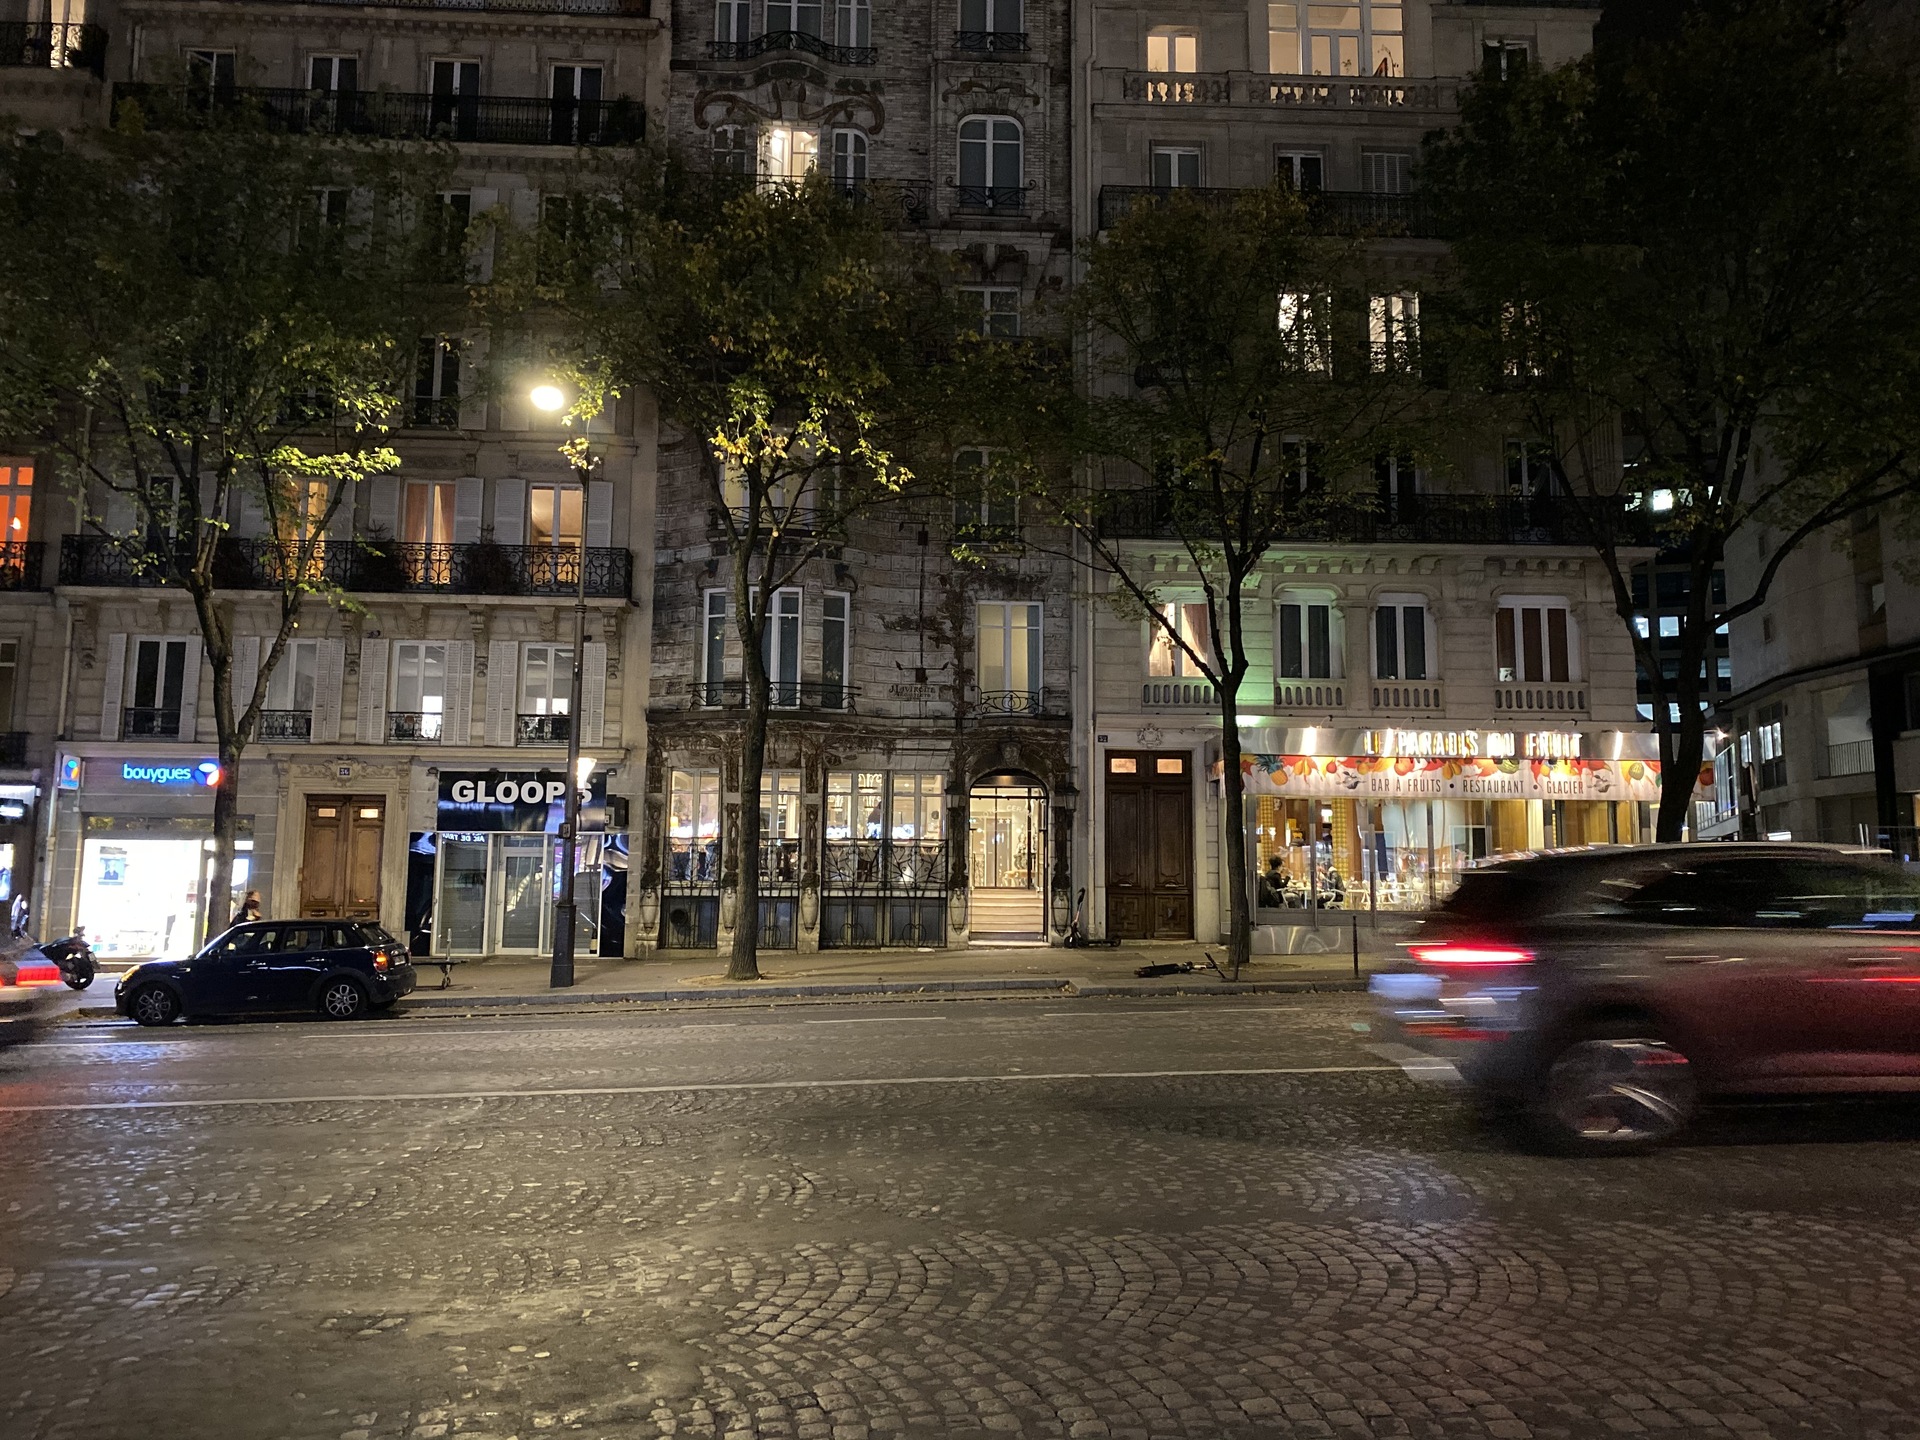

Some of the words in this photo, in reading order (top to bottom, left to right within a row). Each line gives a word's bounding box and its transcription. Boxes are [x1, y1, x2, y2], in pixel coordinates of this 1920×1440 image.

[1397, 730, 1479, 757] PARADIS
[1527, 732, 1582, 757] FRUIT
[123, 763, 191, 783] bouygues
[1371, 778, 1390, 792] BAR
[1396, 777, 1401, 792] À
[1408, 779, 1441, 793] FRUITS
[1463, 779, 1524, 794] RESTAURANT
[1547, 780, 1584, 794] GLACIER
